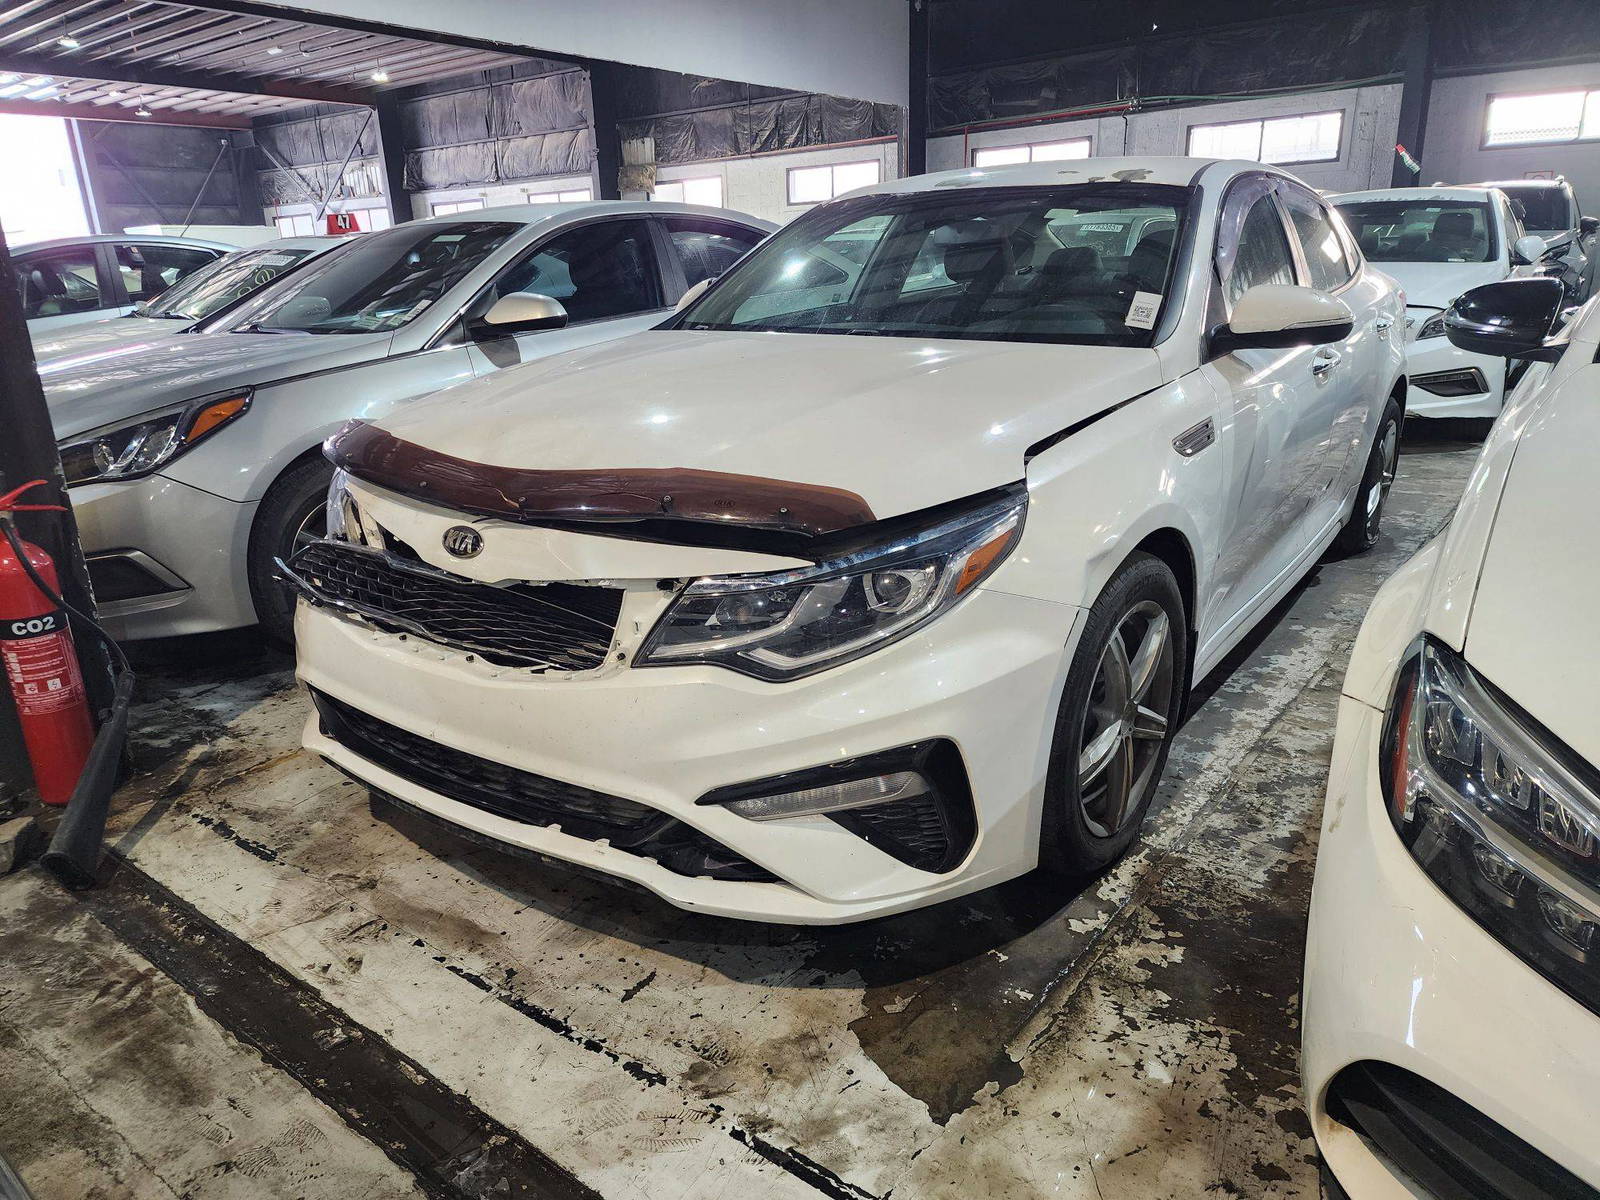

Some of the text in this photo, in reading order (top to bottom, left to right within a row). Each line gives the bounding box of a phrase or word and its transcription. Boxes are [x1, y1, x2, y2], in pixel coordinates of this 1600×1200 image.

[337, 214, 350, 229] 47
[446, 529, 474, 553] KIA
[11, 616, 56, 635] CO2
